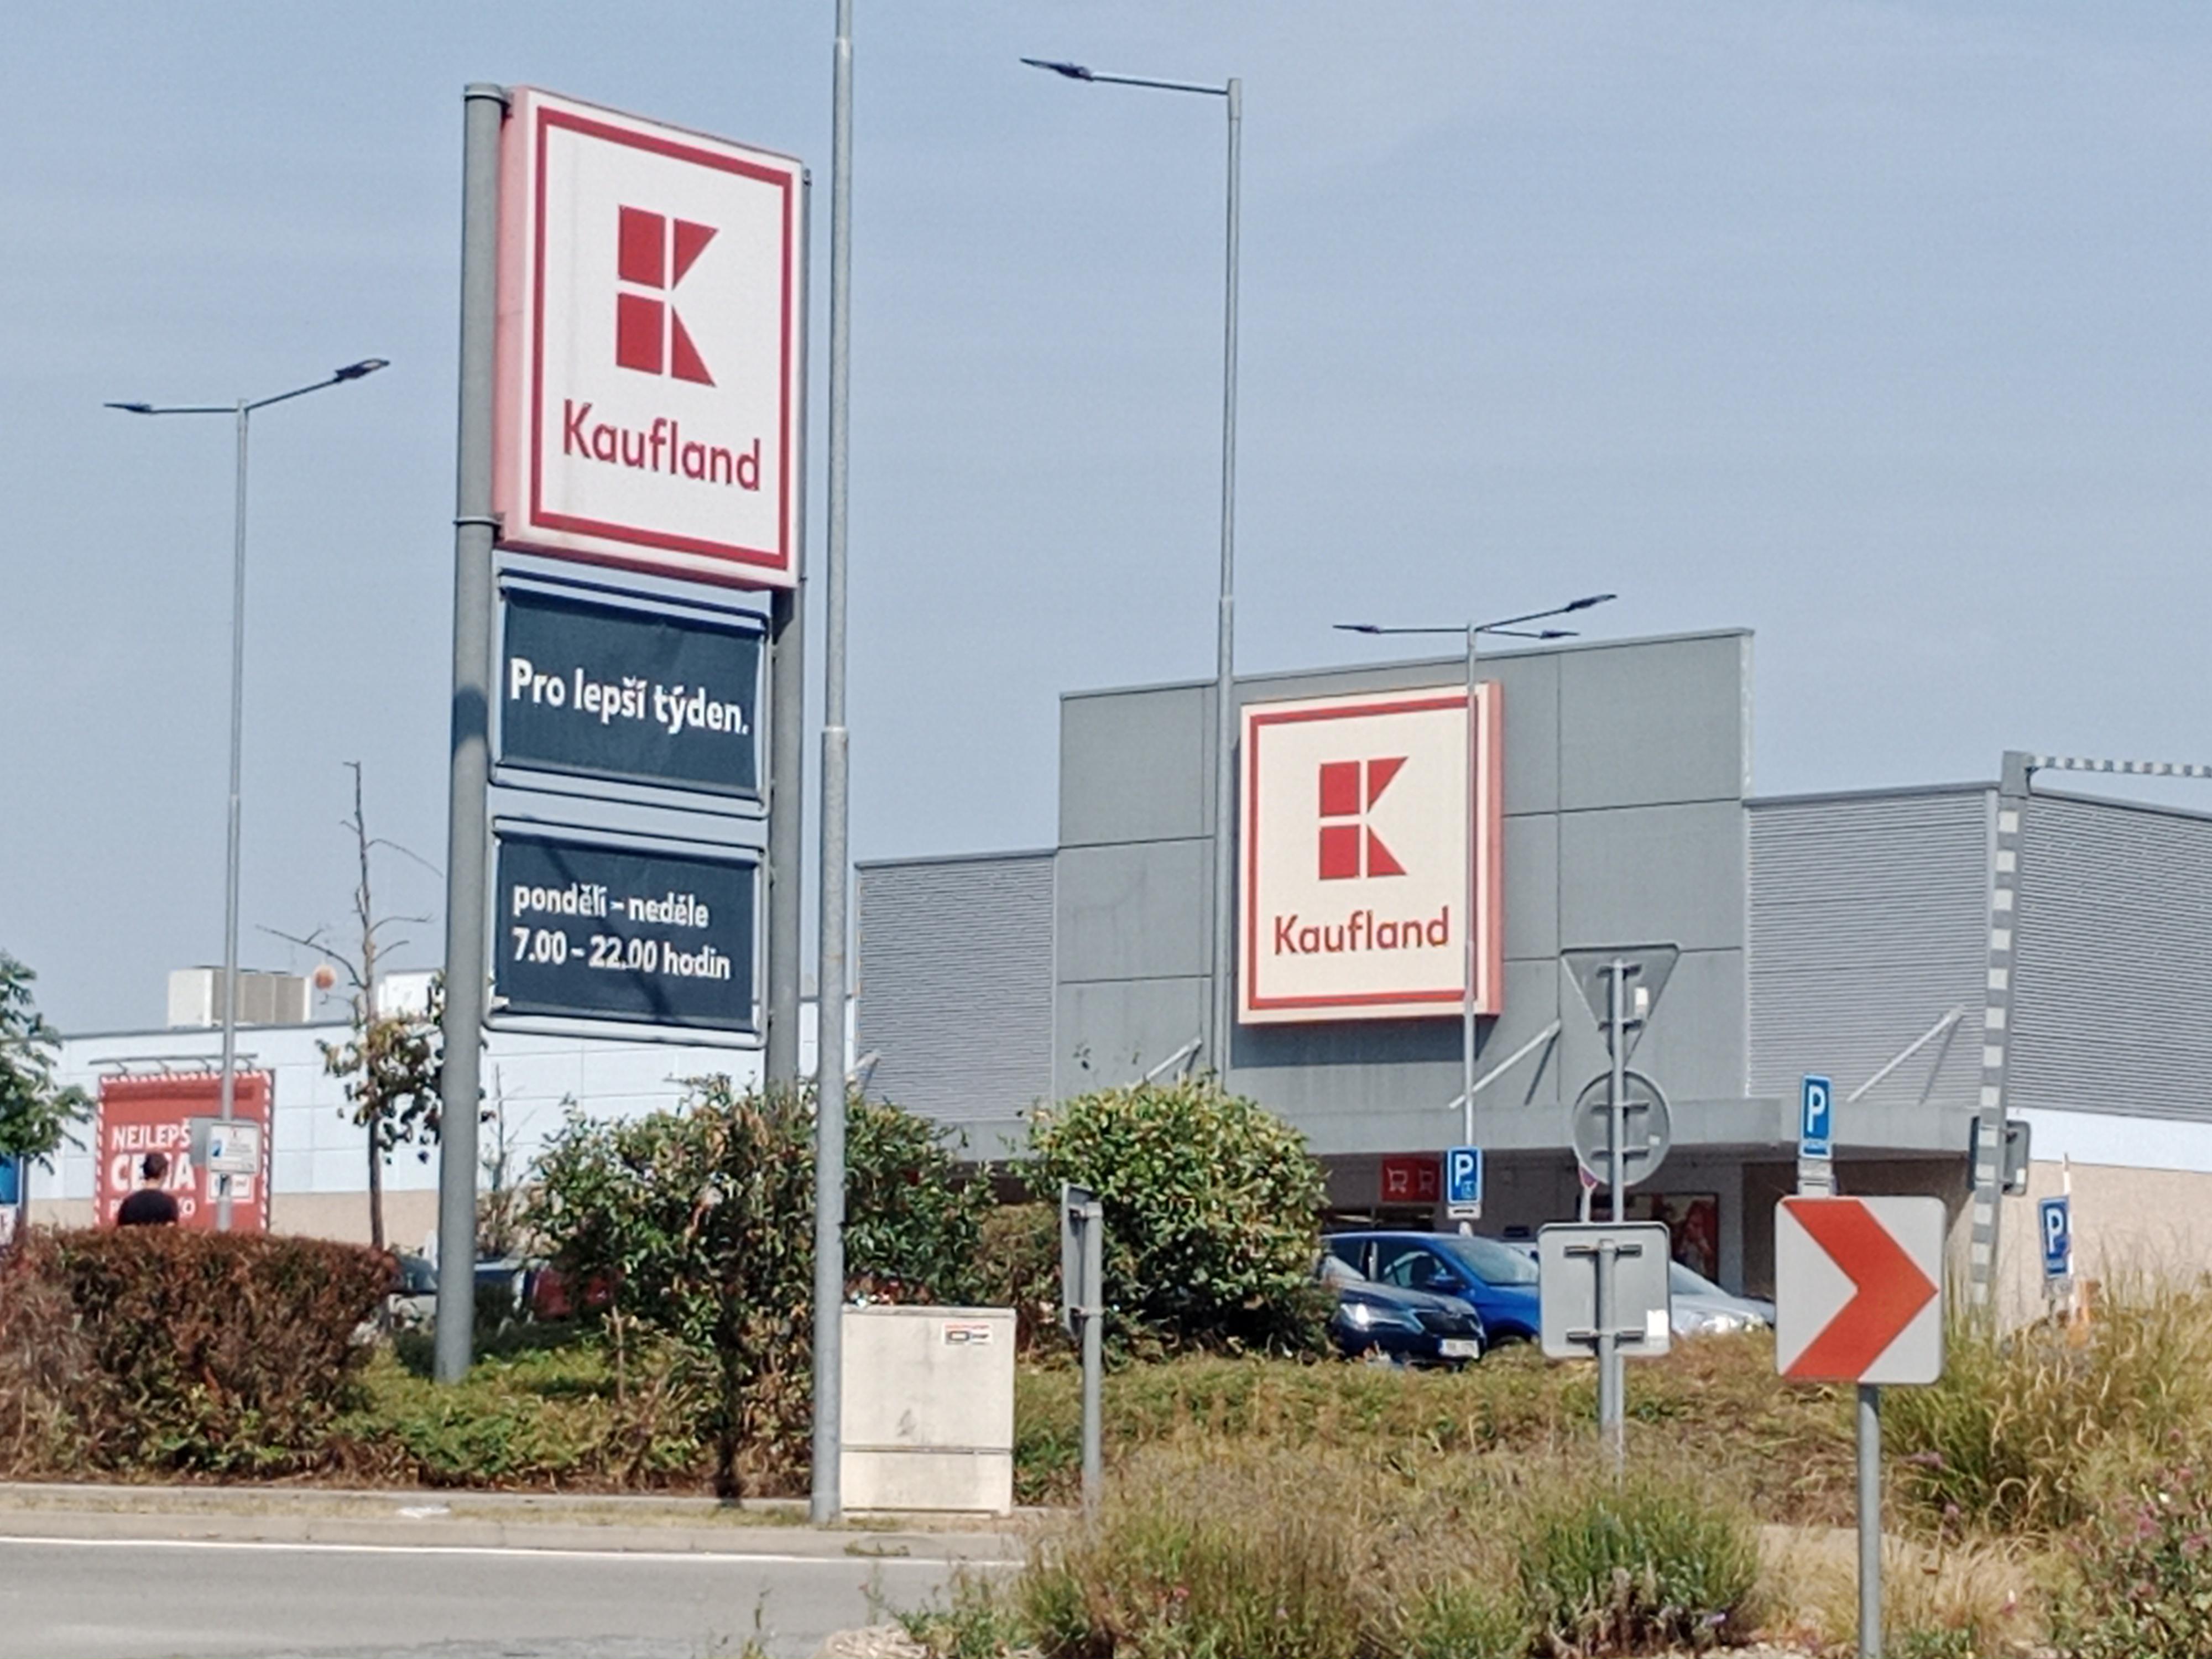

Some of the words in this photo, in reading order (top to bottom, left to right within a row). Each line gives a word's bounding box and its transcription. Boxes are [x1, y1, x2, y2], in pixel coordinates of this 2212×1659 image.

[563, 399, 760, 491] Kaufland
[510, 658, 565, 707] Pro
[573, 667, 647, 724] lepší
[654, 684, 749, 734] týden.
[513, 883, 607, 917] pondělí
[628, 891, 709, 928] neděle
[512, 926, 567, 964] 7.00
[588, 935, 658, 972] 22.00
[664, 942, 730, 979] hodin
[1274, 906, 1449, 955] Kaufland
[1808, 1085, 1825, 1133] P
[112, 1118, 192, 1151] NEJLEPŠ
[1455, 1154, 1474, 1187] P
[2047, 1208, 2064, 1254] P
